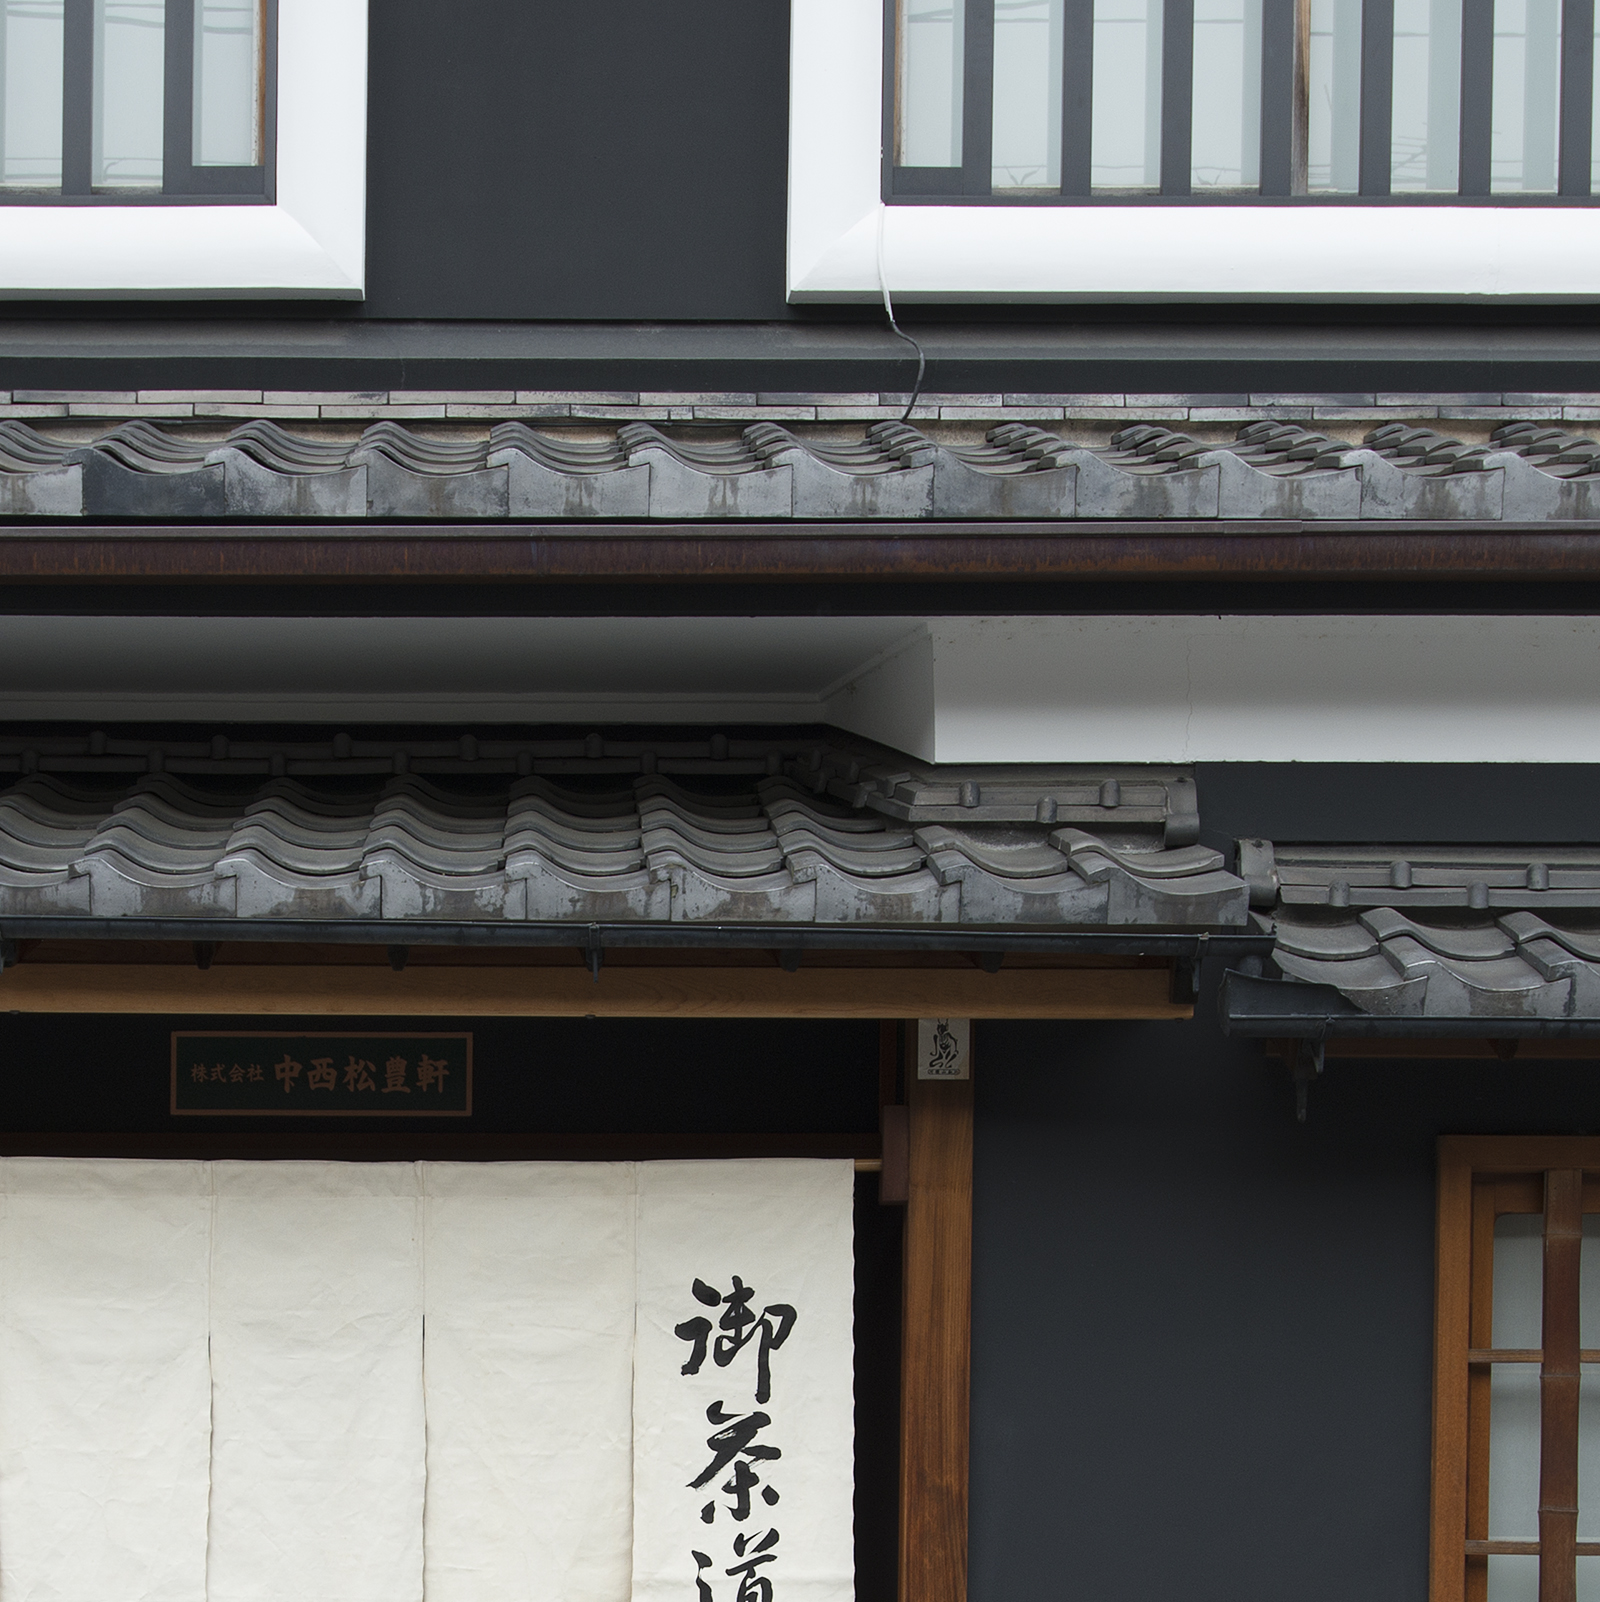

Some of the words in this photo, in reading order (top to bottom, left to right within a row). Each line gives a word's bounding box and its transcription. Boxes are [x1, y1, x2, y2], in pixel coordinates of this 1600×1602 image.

[190, 1063, 265, 1084] 株式会社
[274, 1054, 450, 1094] 中西松豊軒
